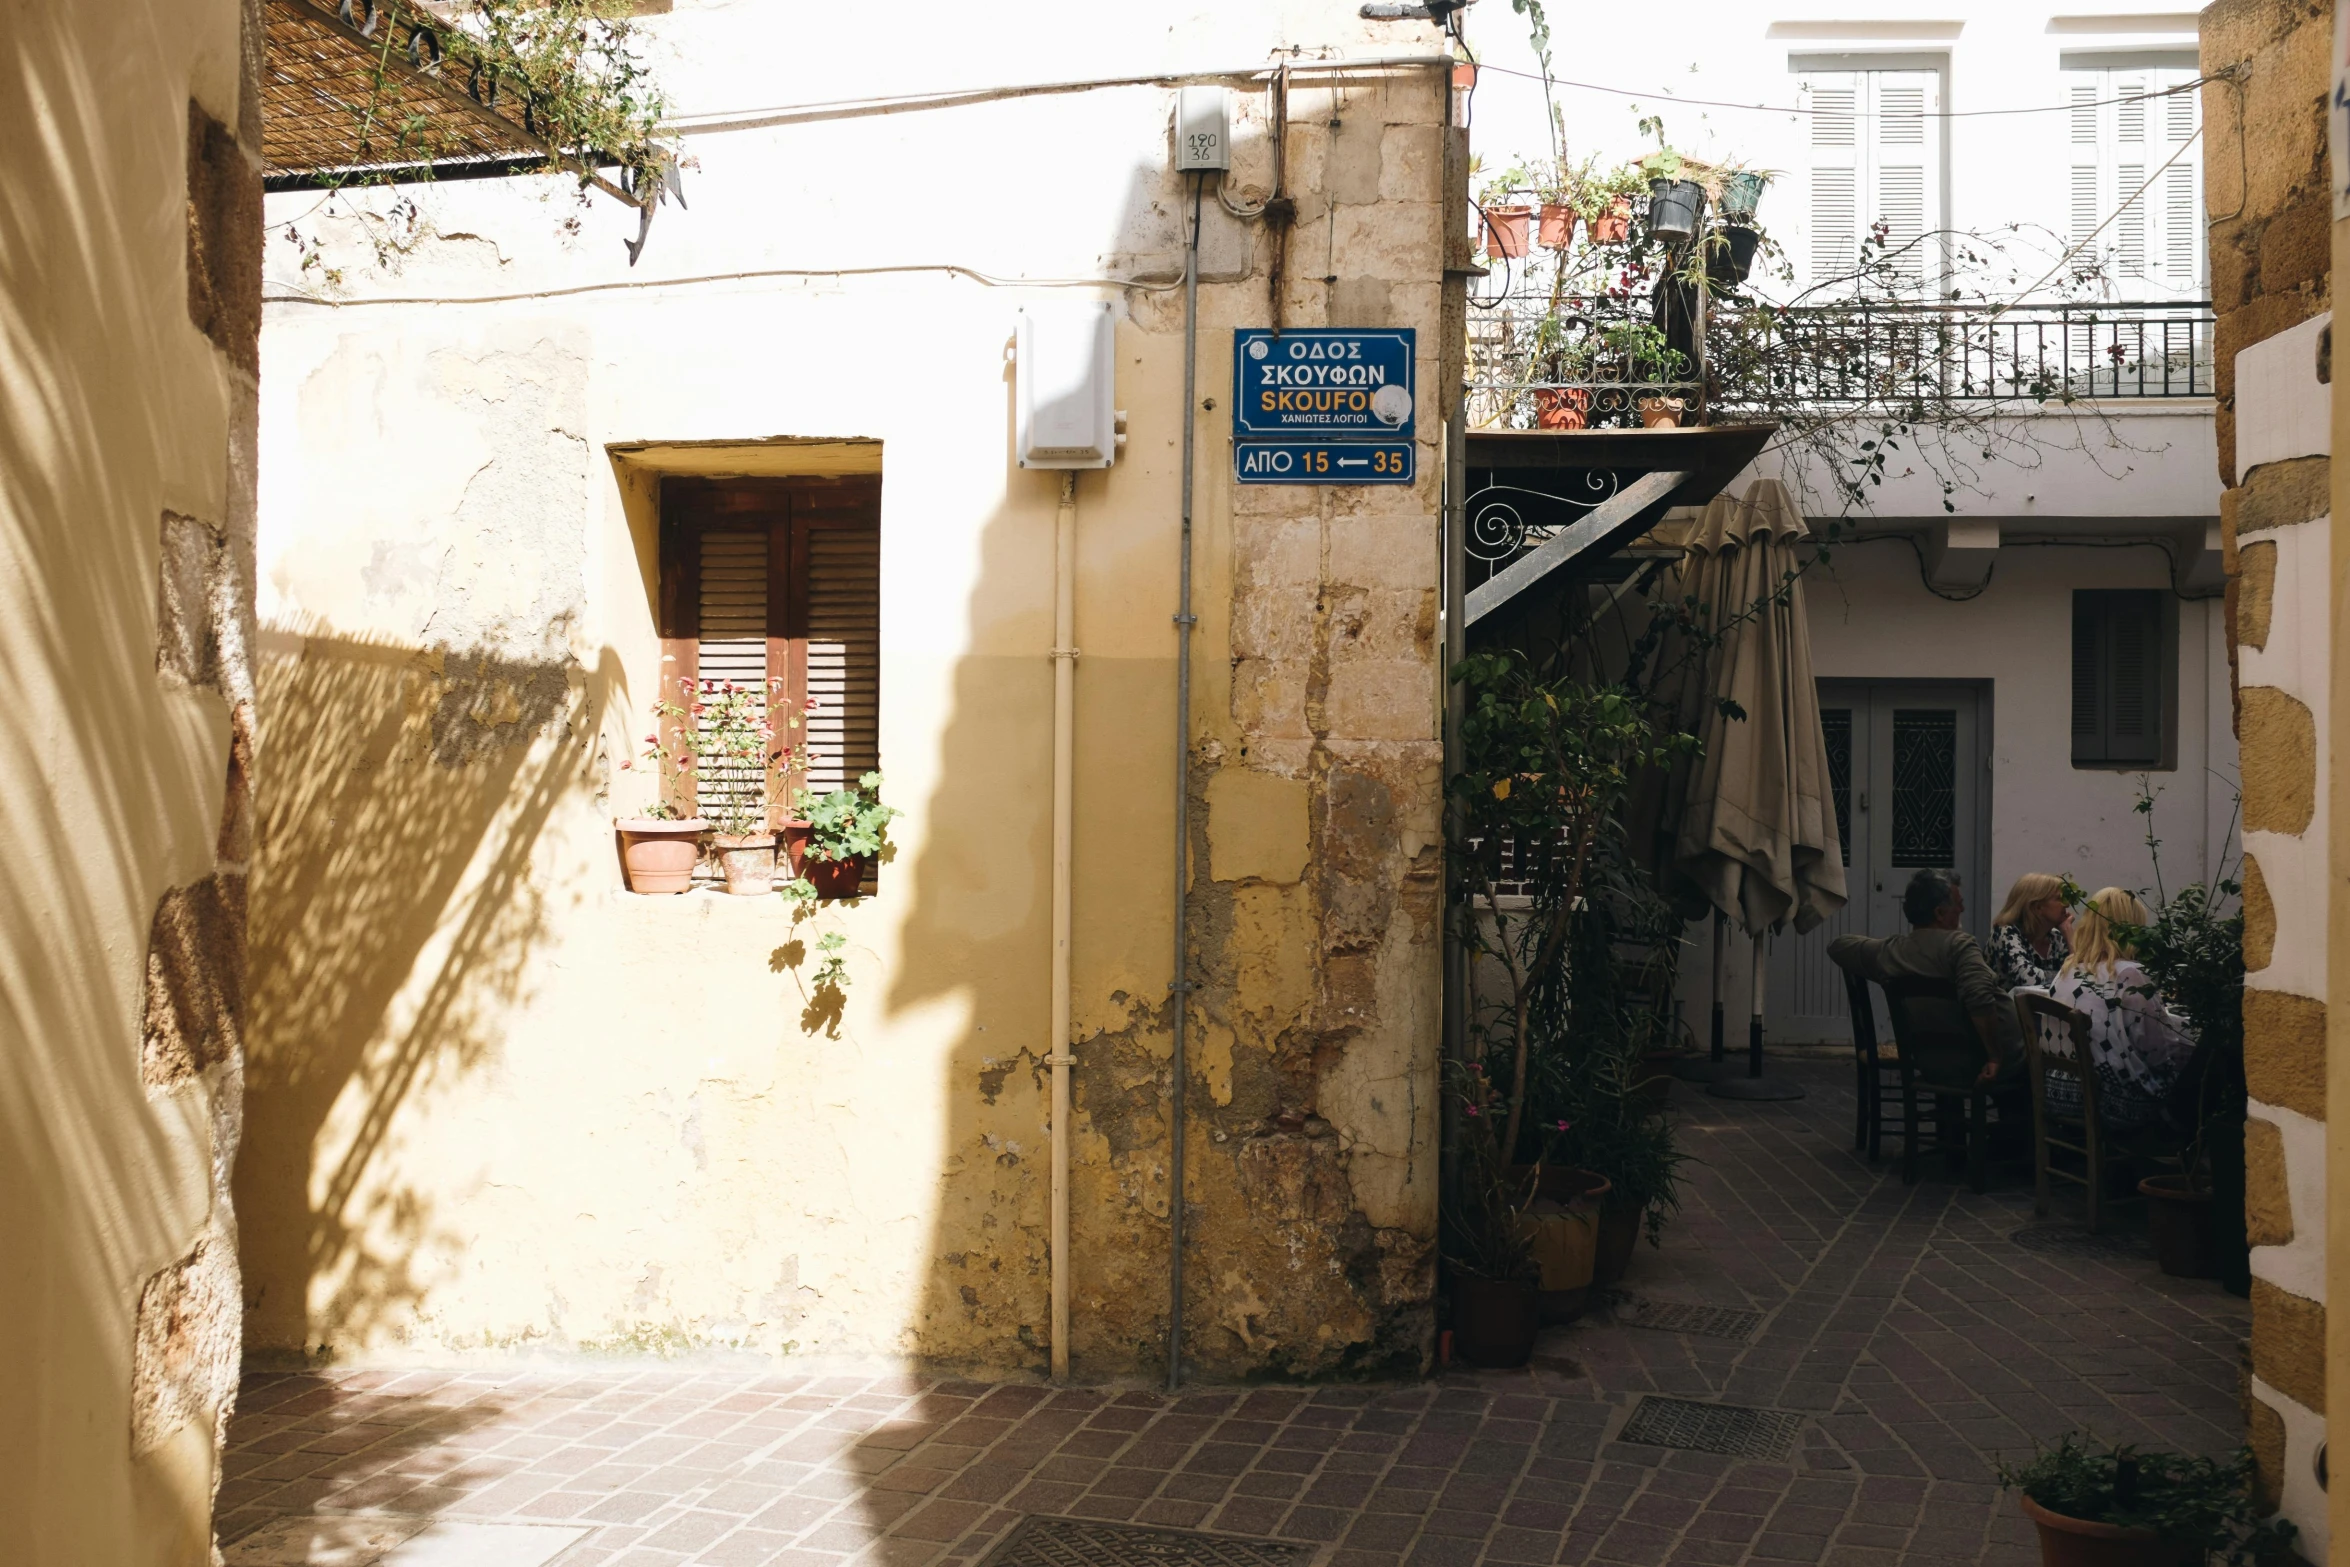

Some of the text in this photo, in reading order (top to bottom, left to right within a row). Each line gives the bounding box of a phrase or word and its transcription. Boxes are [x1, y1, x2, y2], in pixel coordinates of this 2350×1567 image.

[1191, 147, 1210, 160] 36
[1289, 342, 1361, 360] ΟΔΟΣ
[1260, 364, 1385, 385] ΣΚΟΥΦΩΝ
[1281, 414, 1368, 423] ΧΑΝΙΩΤΕΣ ΛΟΓΙΟΙ
[1244, 451, 1403, 473] ΑΠΟ 15 35
